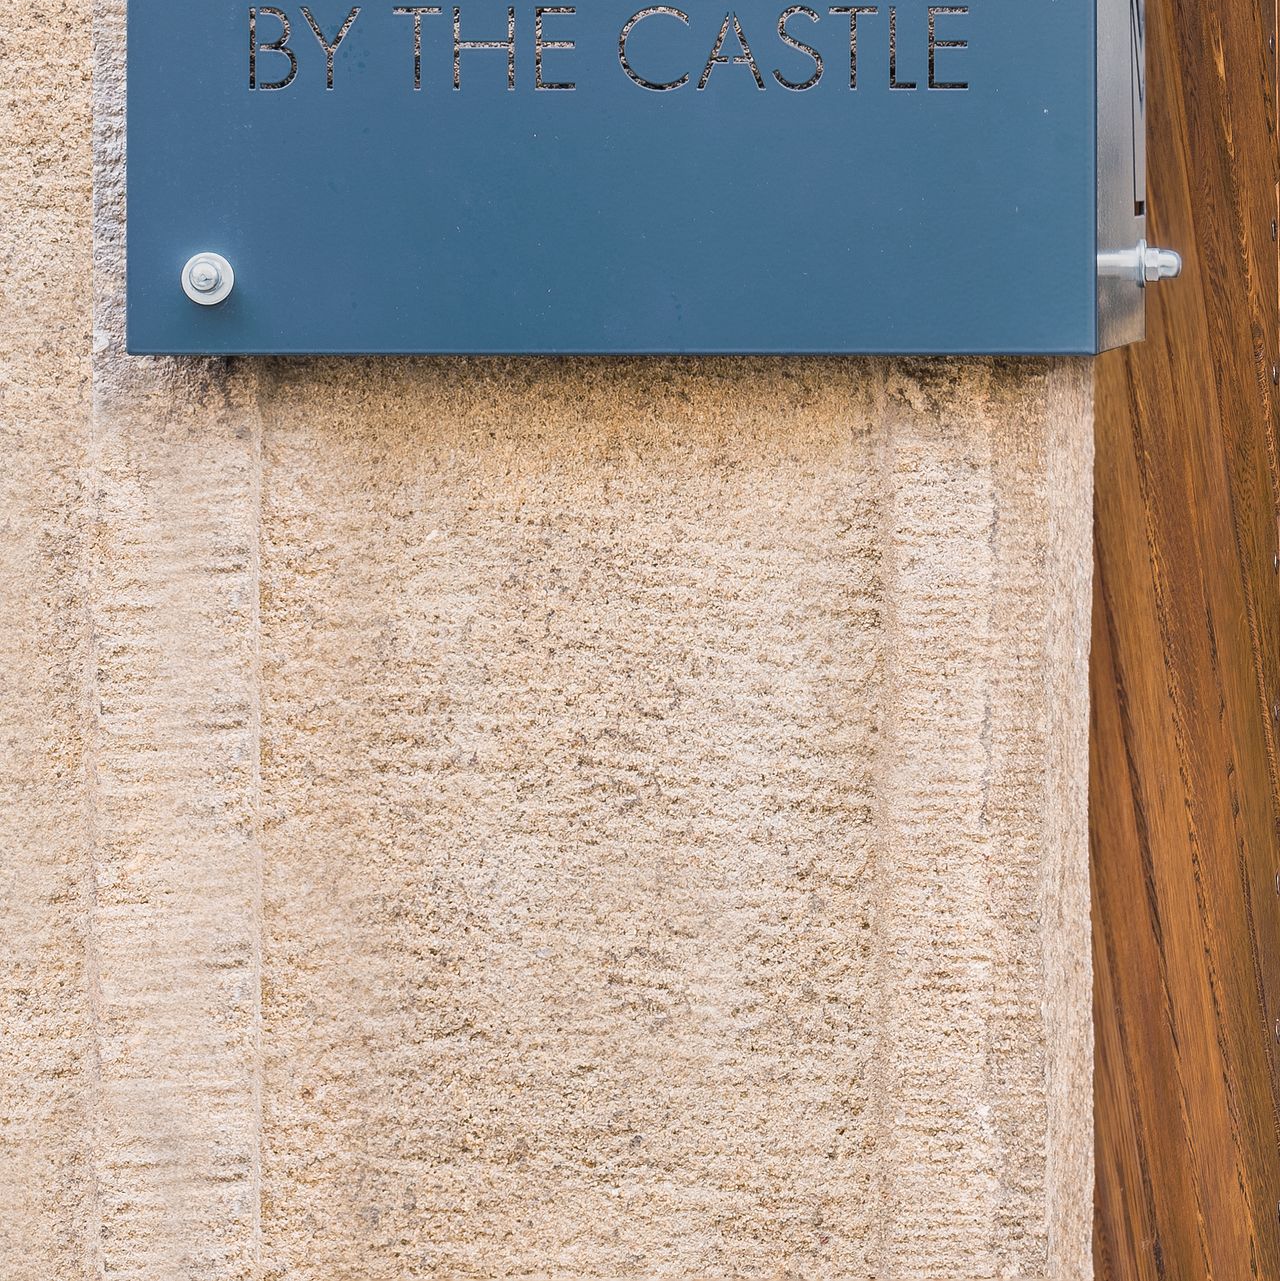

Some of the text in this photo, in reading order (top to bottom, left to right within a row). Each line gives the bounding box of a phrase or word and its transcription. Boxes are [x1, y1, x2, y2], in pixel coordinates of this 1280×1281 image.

[249, 5, 969, 91] BY THE CASTLE
